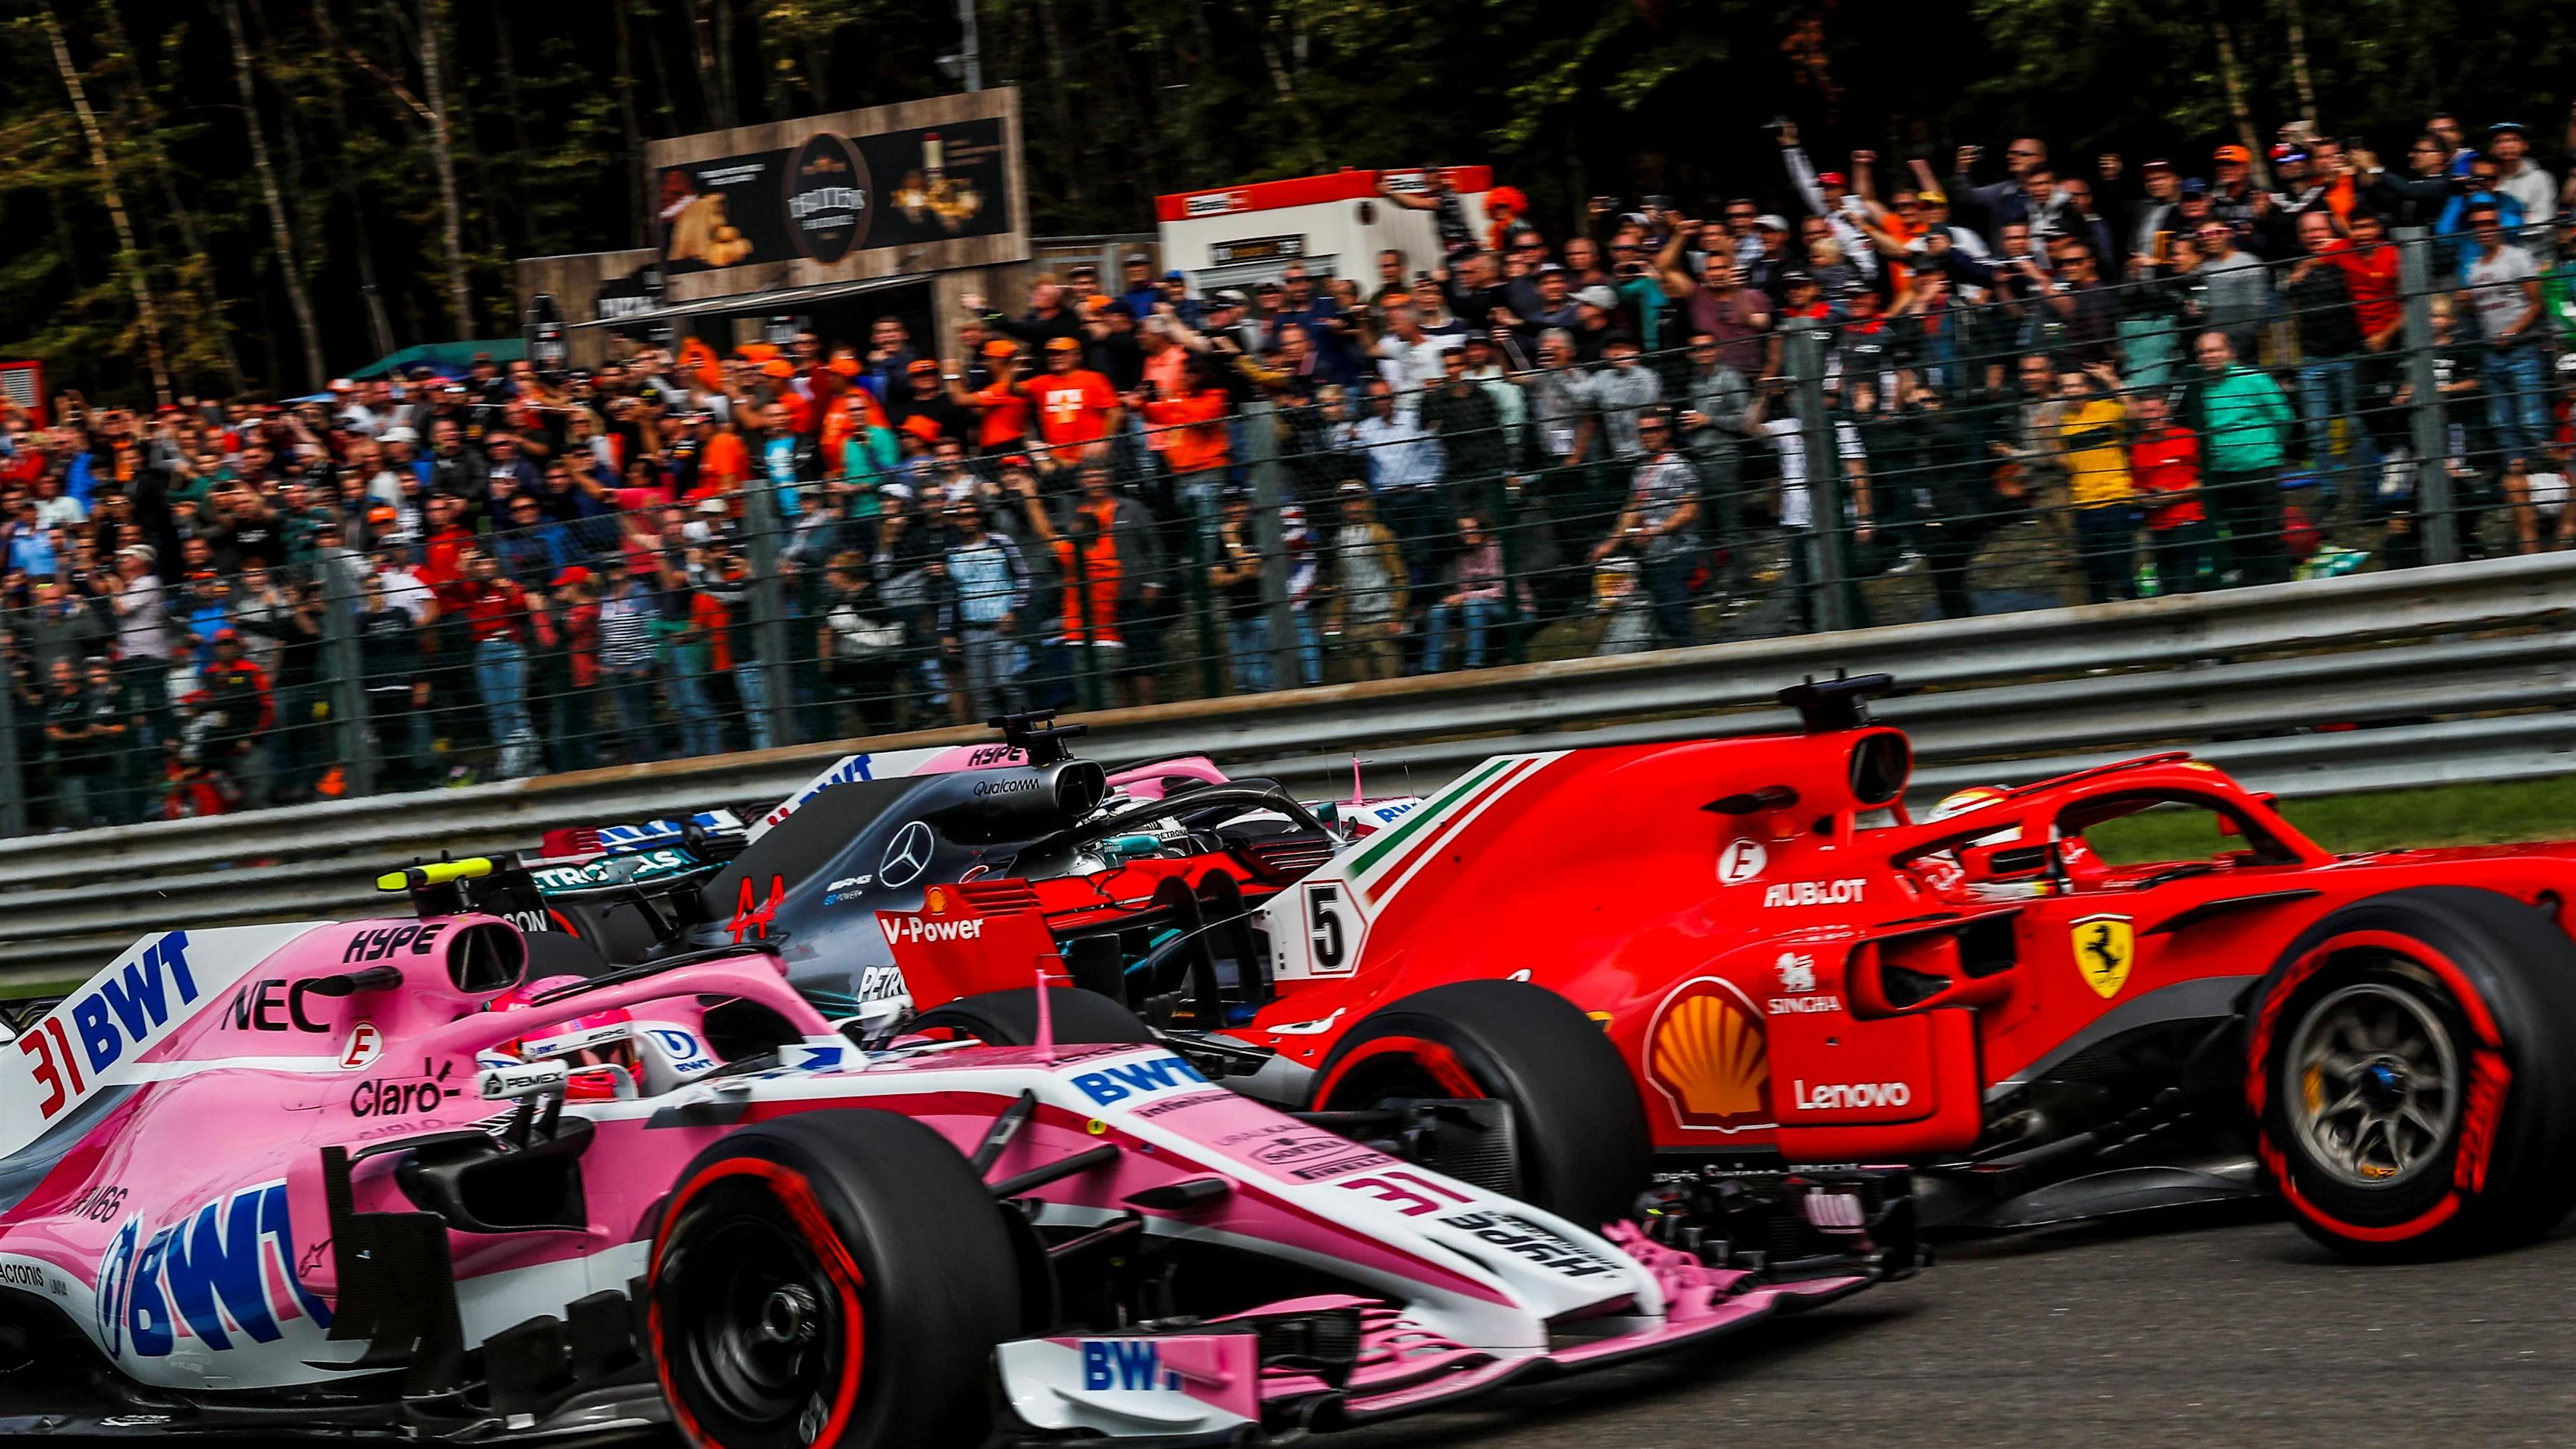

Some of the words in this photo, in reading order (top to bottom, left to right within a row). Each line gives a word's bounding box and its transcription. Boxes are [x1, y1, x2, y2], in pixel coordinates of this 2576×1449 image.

[968, 747, 1023, 766] HYPE
[973, 778, 1040, 797] Qualcomm
[1729, 842, 1754, 879] E
[724, 873, 785, 943] 44
[1763, 879, 1867, 908] HUBLOT
[343, 923, 449, 963] HYPE
[880, 917, 983, 944] V-Power
[1309, 886, 1344, 969] 5
[72, 930, 199, 1075] BWT
[221, 978, 332, 1033] NEC
[1768, 996, 1842, 1015] SINGHA
[344, 1028, 374, 1065] E
[674, 1059, 714, 1072] BWT
[18, 1017, 86, 1120] 31
[506, 1072, 565, 1088] PEMEX
[1071, 1056, 1211, 1107] BWT
[351, 1078, 440, 1117] Claro
[1795, 1079, 1911, 1110] Lenovo
[1337, 1171, 1477, 1217] 31
[1435, 1213, 1610, 1277] HYPE
[129, 1181, 335, 1357] BWT
